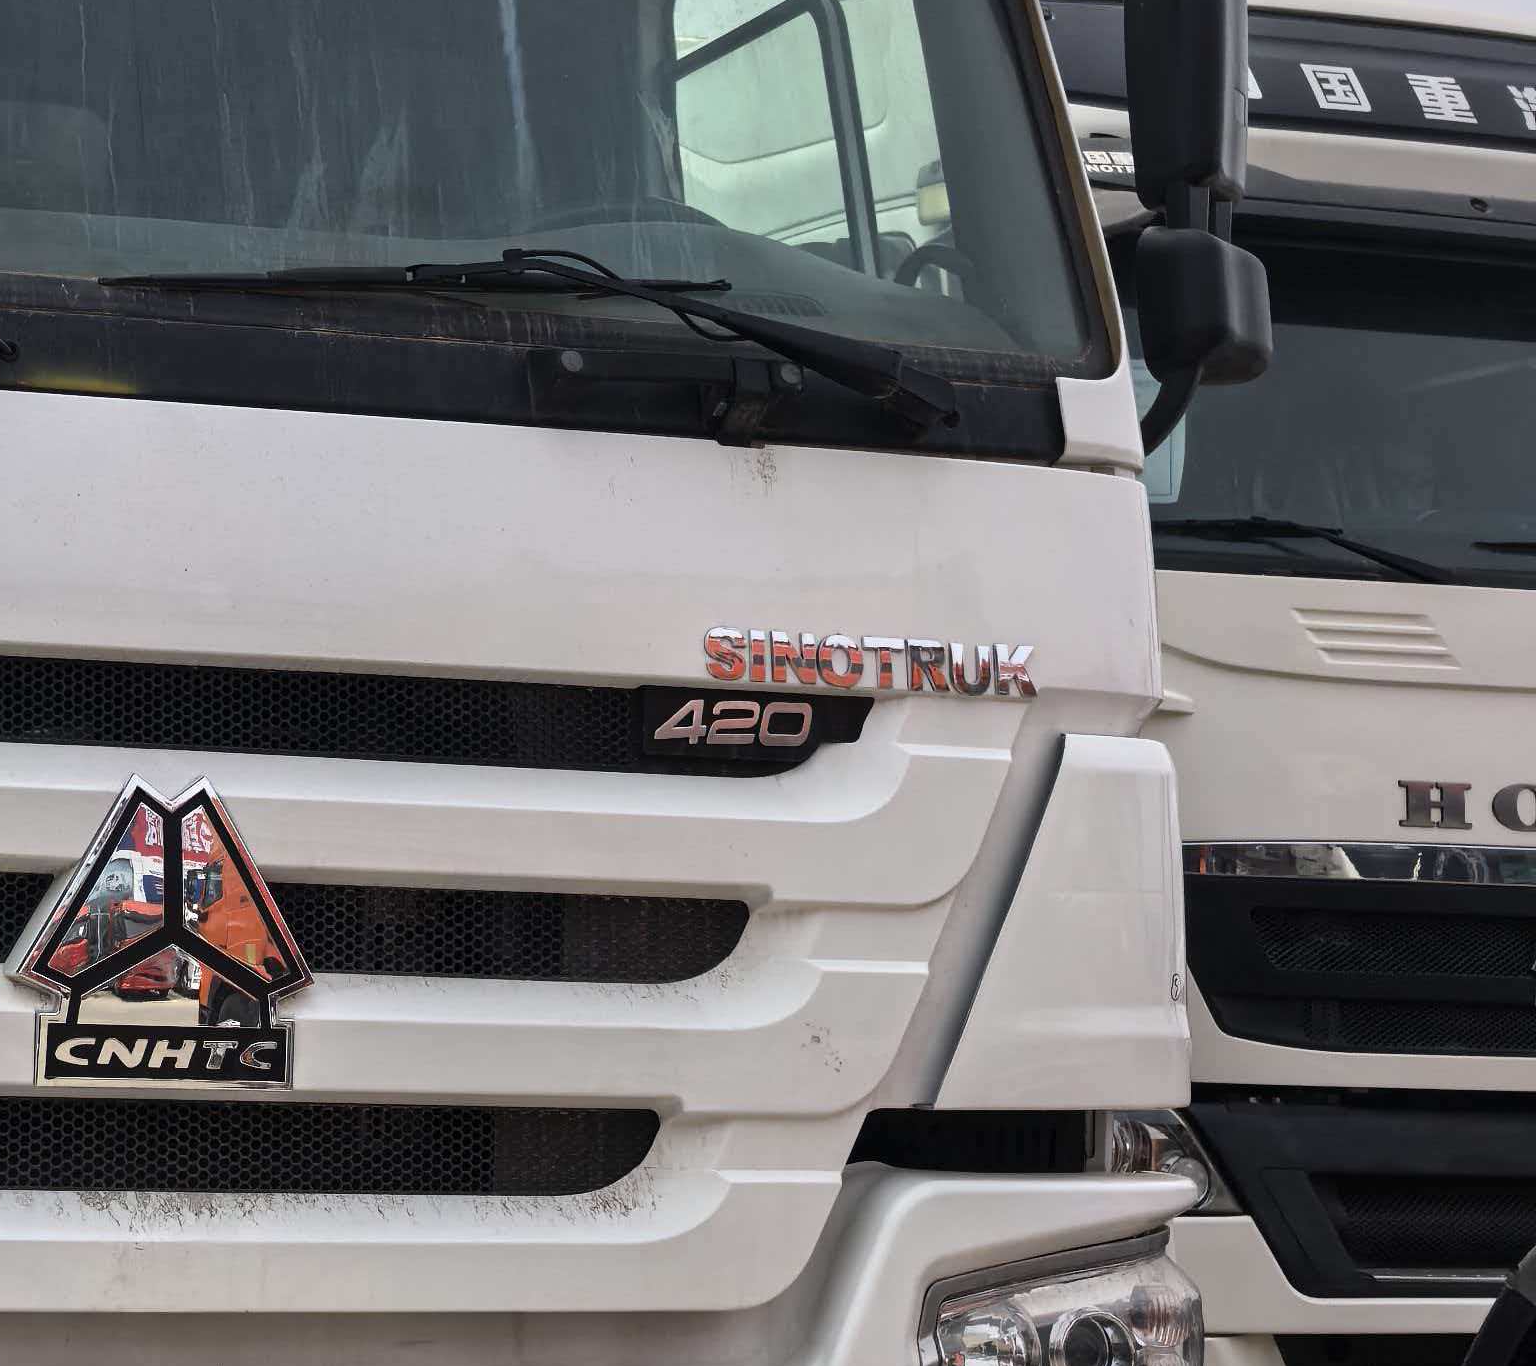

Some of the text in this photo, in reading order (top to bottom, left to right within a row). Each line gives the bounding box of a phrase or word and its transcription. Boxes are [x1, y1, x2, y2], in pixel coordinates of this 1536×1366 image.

[1248, 63, 1536, 131] 国重
[703, 625, 1040, 698] SINOTRUK
[653, 699, 813, 747] 420
[54, 1036, 278, 1070] CNHTC
